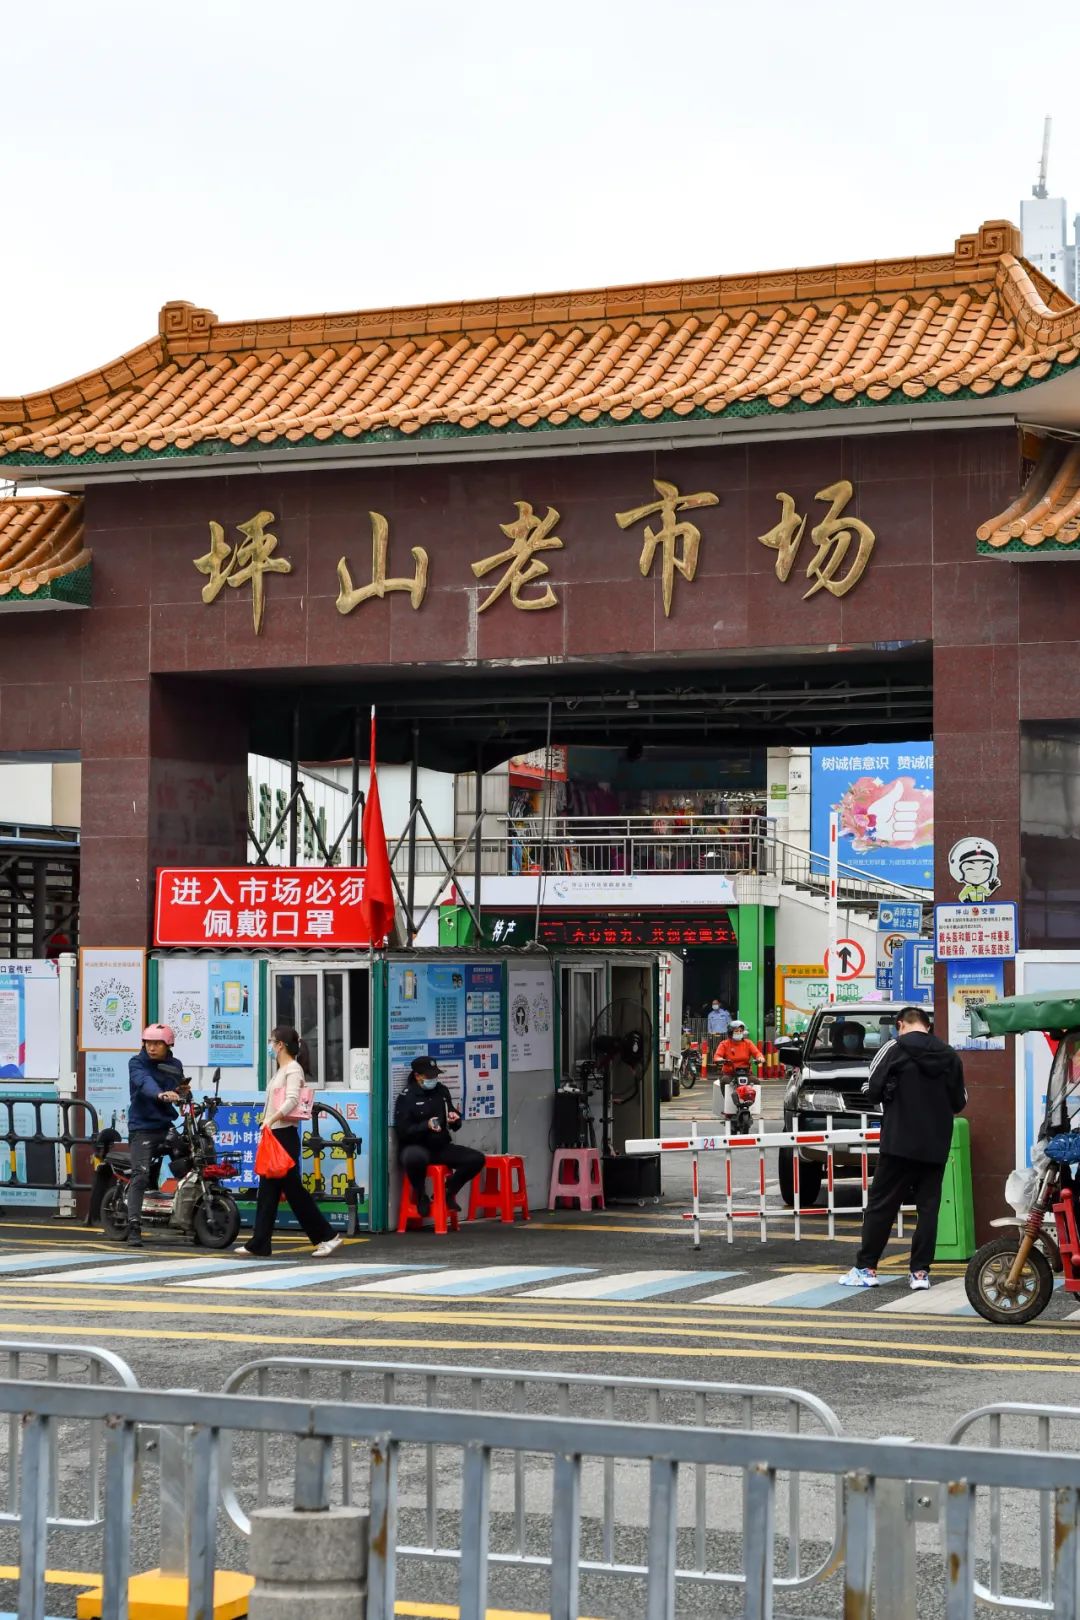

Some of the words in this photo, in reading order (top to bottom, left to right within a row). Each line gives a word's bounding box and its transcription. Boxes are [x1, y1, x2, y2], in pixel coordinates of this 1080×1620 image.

[193, 480, 876, 636] 坪山老市场
[821, 756, 890, 771] 树诚信意识
[170, 876, 366, 906] 进入市场必须
[203, 909, 335, 938] 佩戴口罩
[491, 919, 517, 942] 特产
[572, 928, 738, 942] 齐心协力、共创全国文
[703, 1138, 715, 1150] 24
